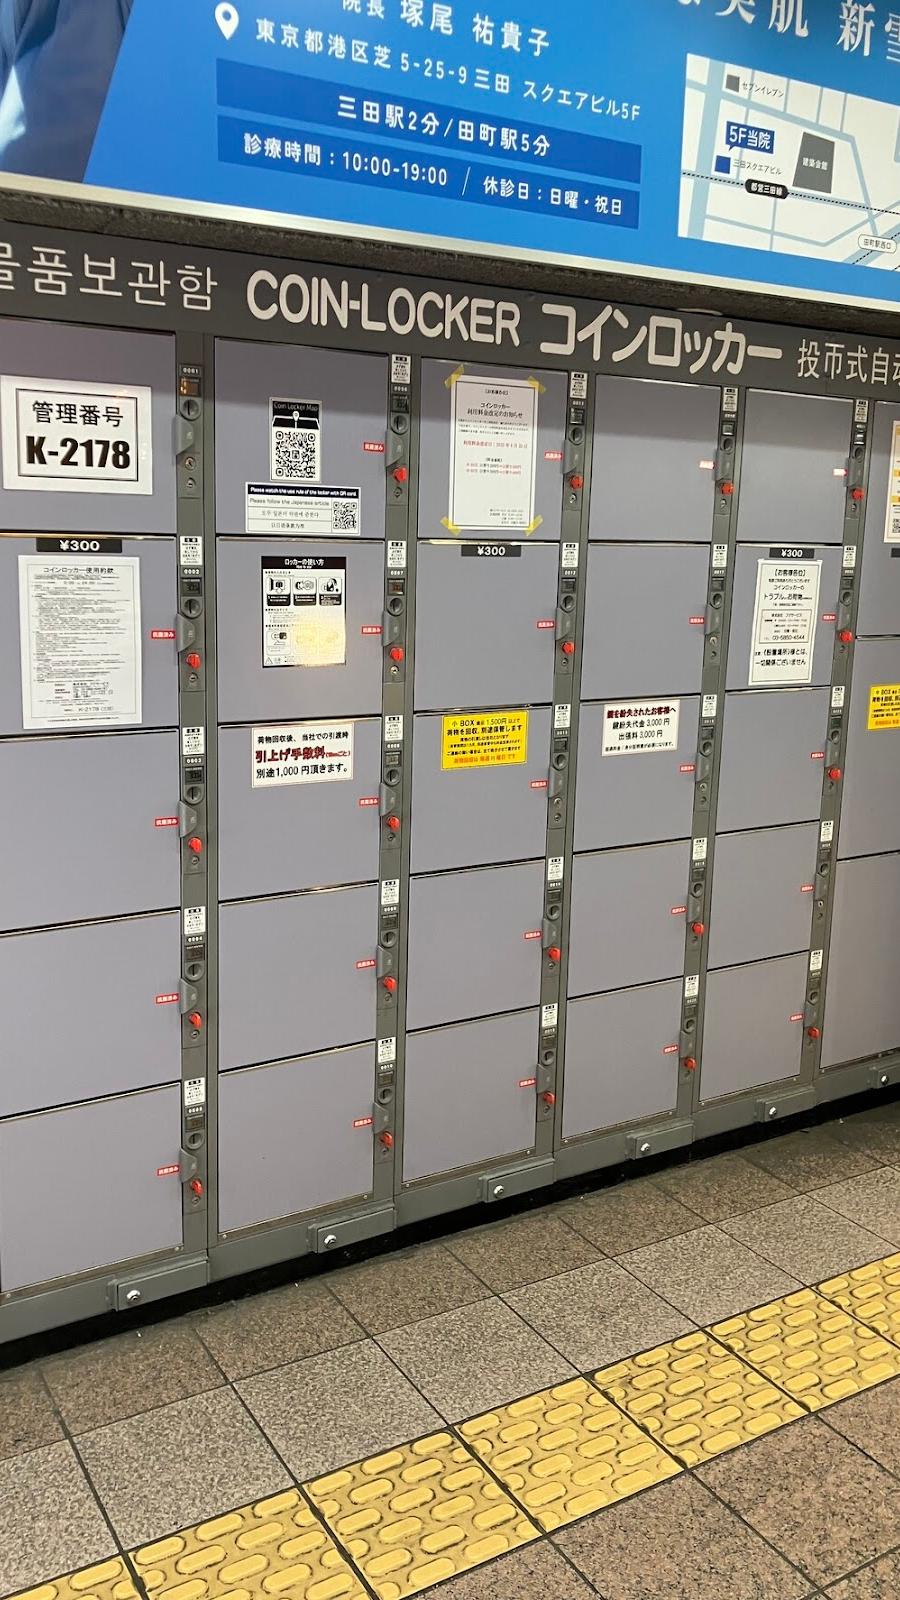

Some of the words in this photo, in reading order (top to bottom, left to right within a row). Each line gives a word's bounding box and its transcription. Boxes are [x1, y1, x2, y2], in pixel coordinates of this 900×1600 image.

[472, 12, 550, 57] 祐貴子
[729, 124, 771, 150] 5F当院
[802, 157, 828, 171] 建築会館
[750, 181, 783, 197] 都営三田線
[246, 269, 521, 347] COIN-LOCKER
[540, 302, 783, 376] コインロッカー
[32, 400, 124, 427] 管理番号
[26, 435, 130, 470] K-2178
[59, 540, 100, 552] ¥300
[477, 546, 506, 556] ¥300
[780, 548, 803, 558] ¥300
[607, 706, 676, 718] 鍵を紛失されたお客様へ
